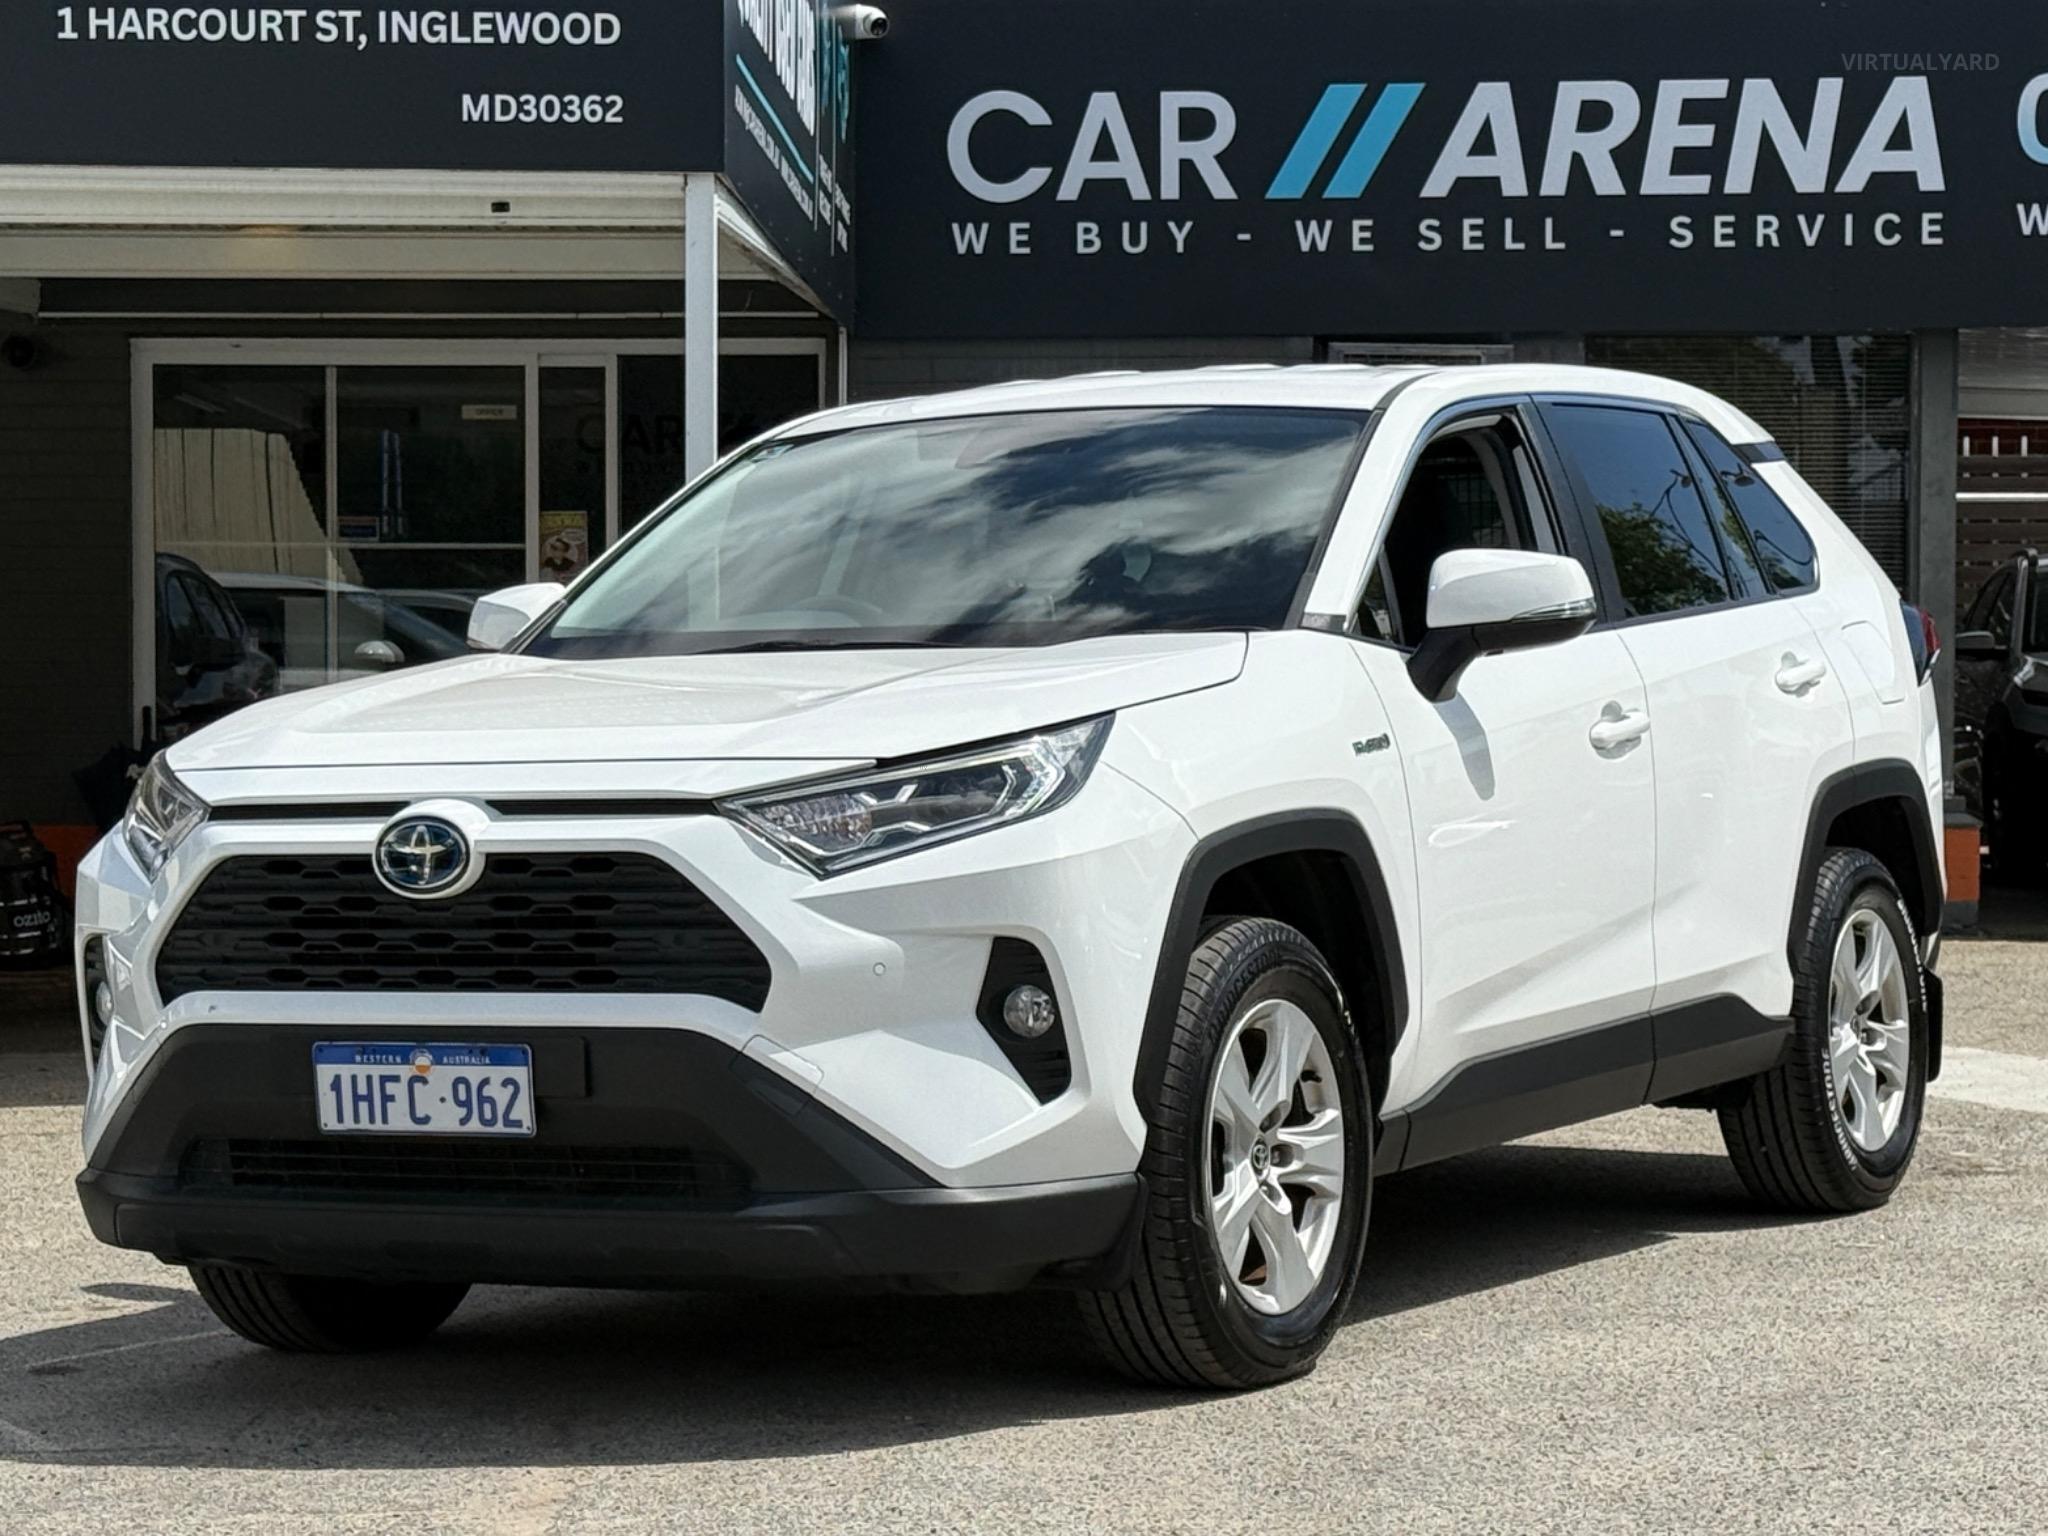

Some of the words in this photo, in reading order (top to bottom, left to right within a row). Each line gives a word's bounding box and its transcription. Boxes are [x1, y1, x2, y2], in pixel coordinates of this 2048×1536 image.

[58, 7, 78, 39] 1
[89, 7, 306, 42] HARCOURT
[316, 9, 367, 50] ST,
[379, 11, 621, 45] INGLEWOOD
[462, 93, 623, 122] MD30362
[946, 90, 1238, 203] CAR
[1419, 76, 1946, 198] ARENA
[951, 222, 1031, 254] WE
[1077, 221, 1193, 254] BUY
[1295, 219, 1374, 252] WE
[1418, 217, 1566, 251] SELL
[1669, 212, 1944, 248] SERVICE
[355, 1054, 402, 1064] WESTERN
[442, 1055, 491, 1065] AUSTRALIA
